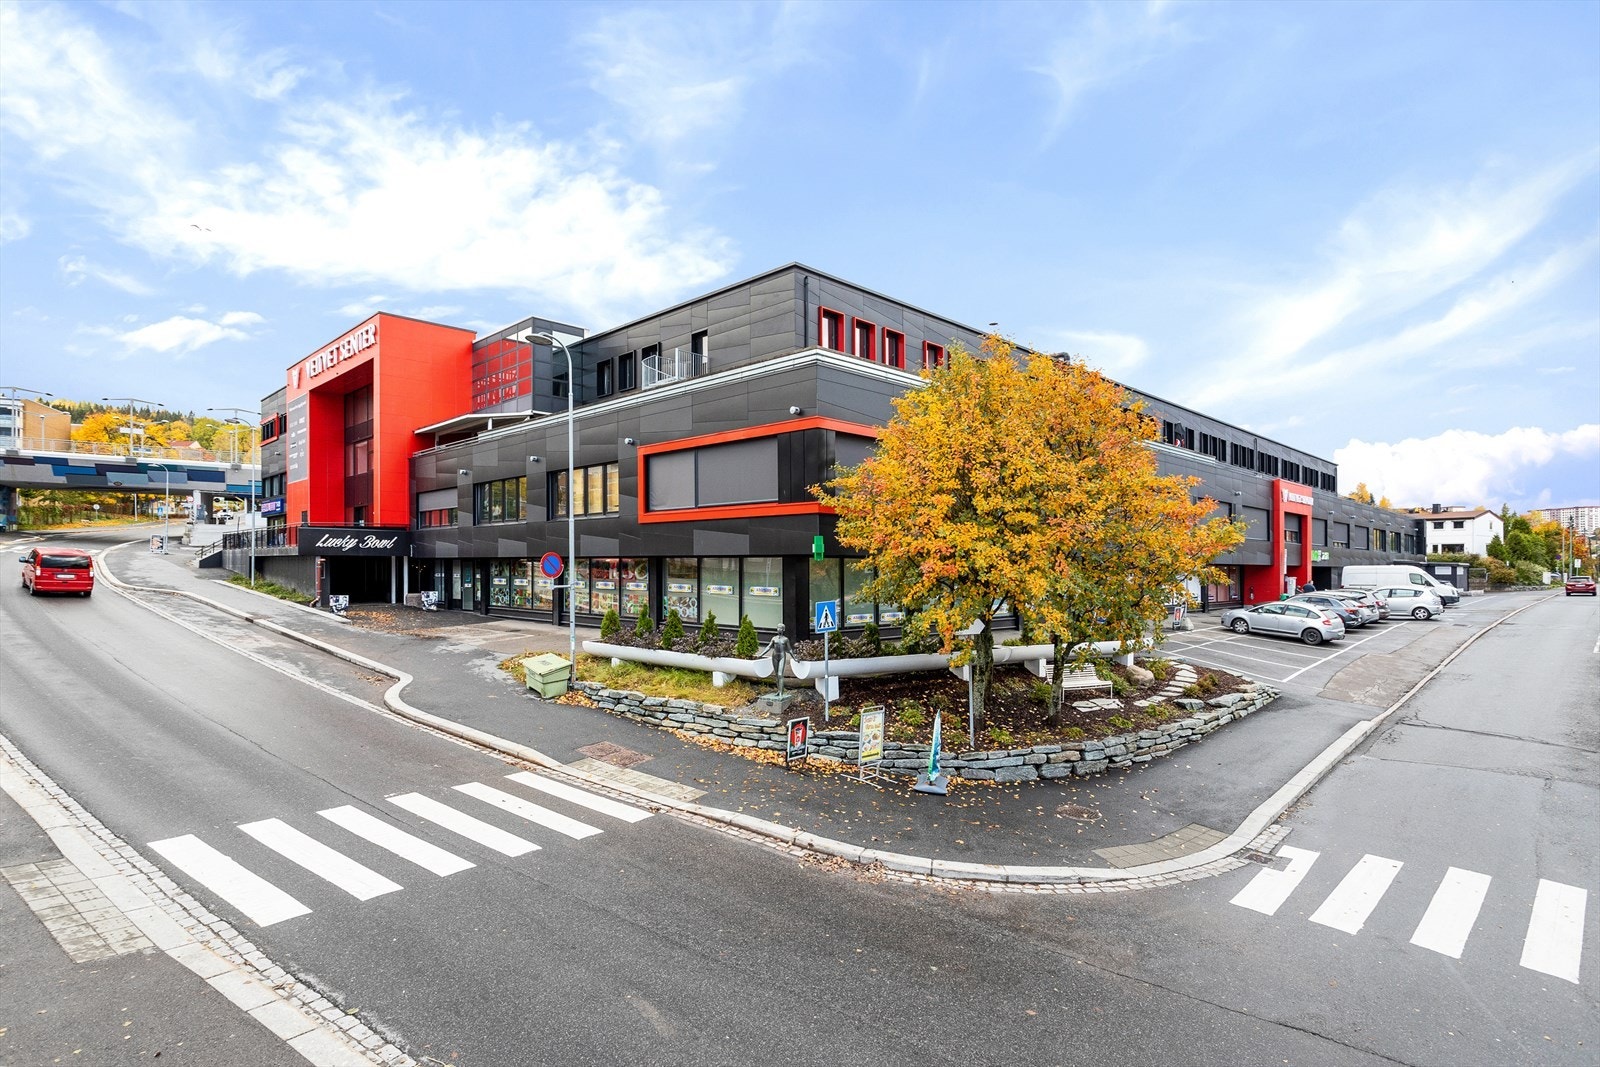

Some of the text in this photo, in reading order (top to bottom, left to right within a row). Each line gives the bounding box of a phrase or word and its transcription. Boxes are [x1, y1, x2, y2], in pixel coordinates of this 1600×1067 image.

[339, 323, 376, 361] SENTER
[315, 533, 398, 552] Lucky Bowl
